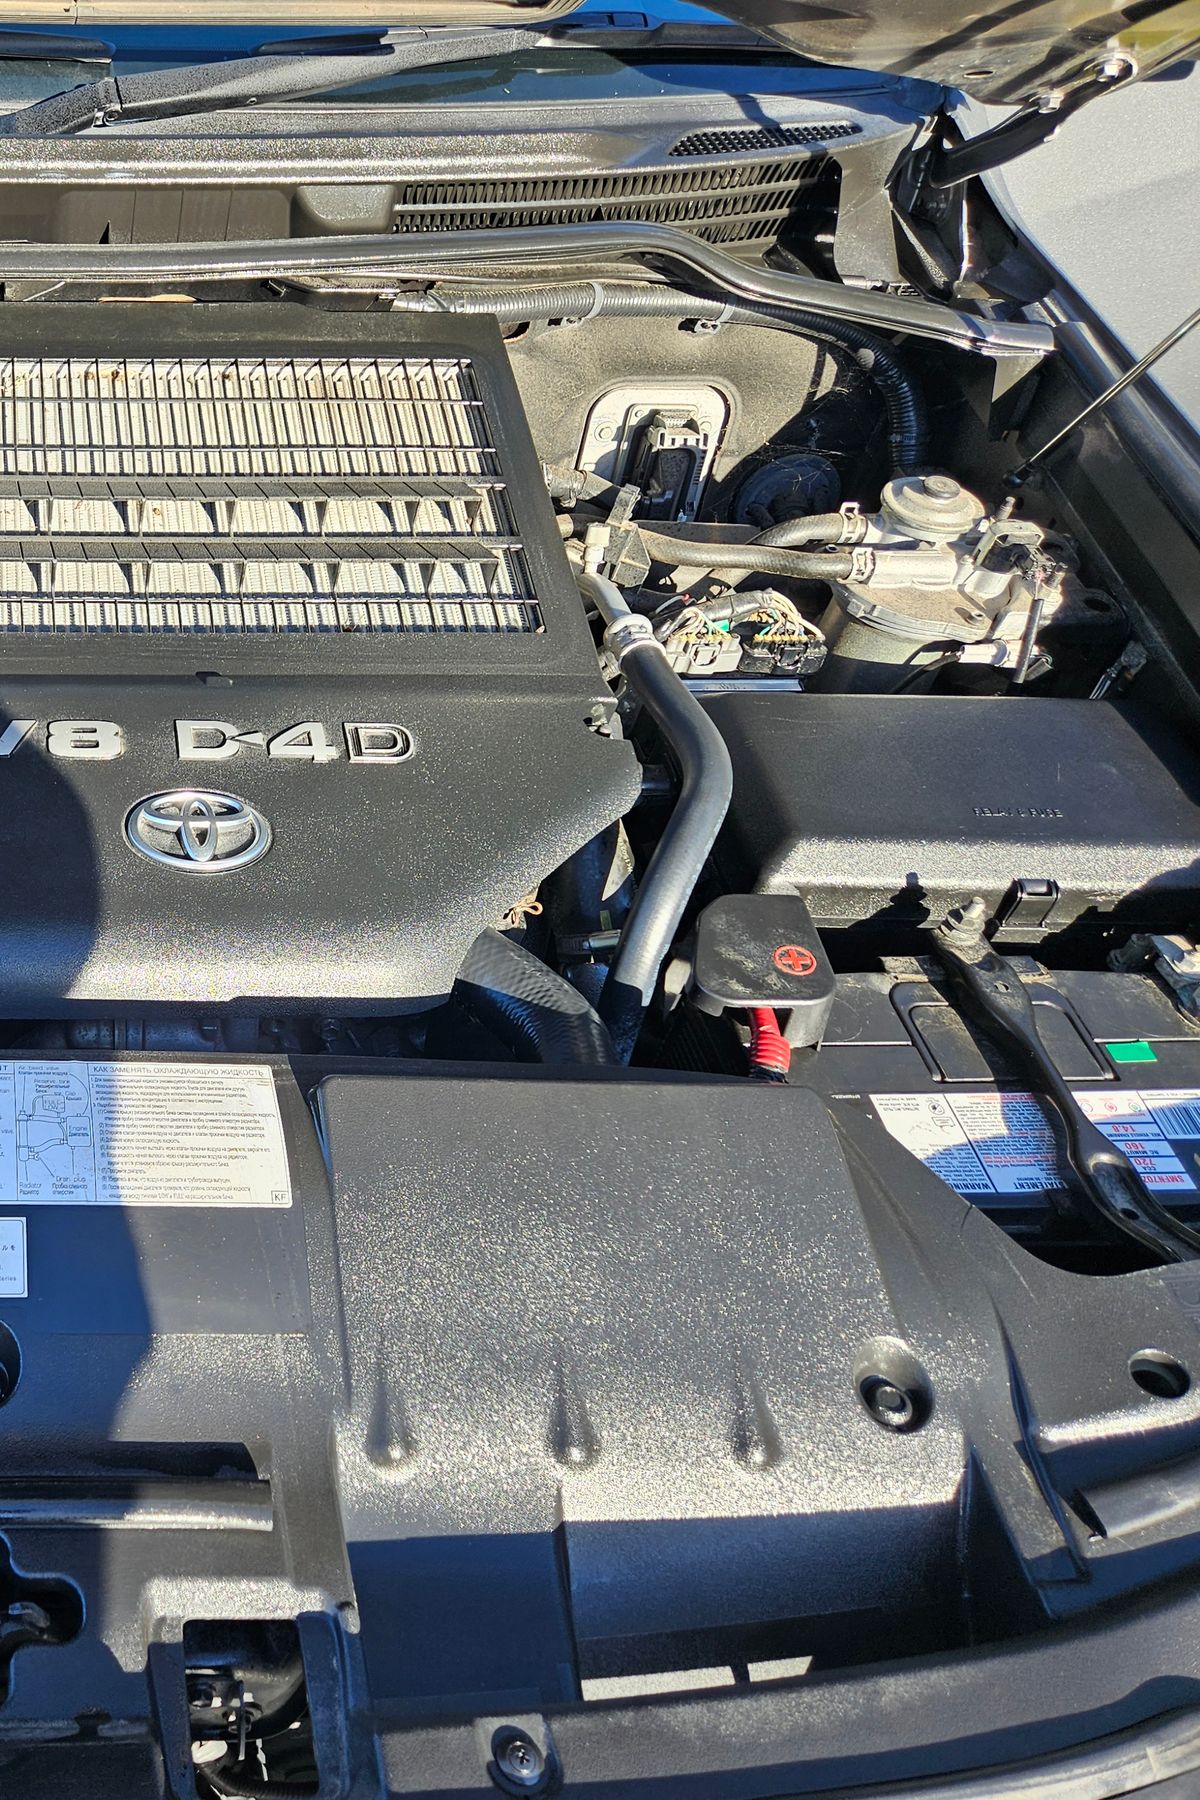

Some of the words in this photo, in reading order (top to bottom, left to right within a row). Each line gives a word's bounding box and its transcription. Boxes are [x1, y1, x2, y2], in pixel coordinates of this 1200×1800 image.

[153, 1067, 218, 1076] ОХЛАЖДАЮЩУЮ
[220, 1068, 264, 1077] ЖИДКОСТЬ
[274, 1192, 287, 1201] KF
